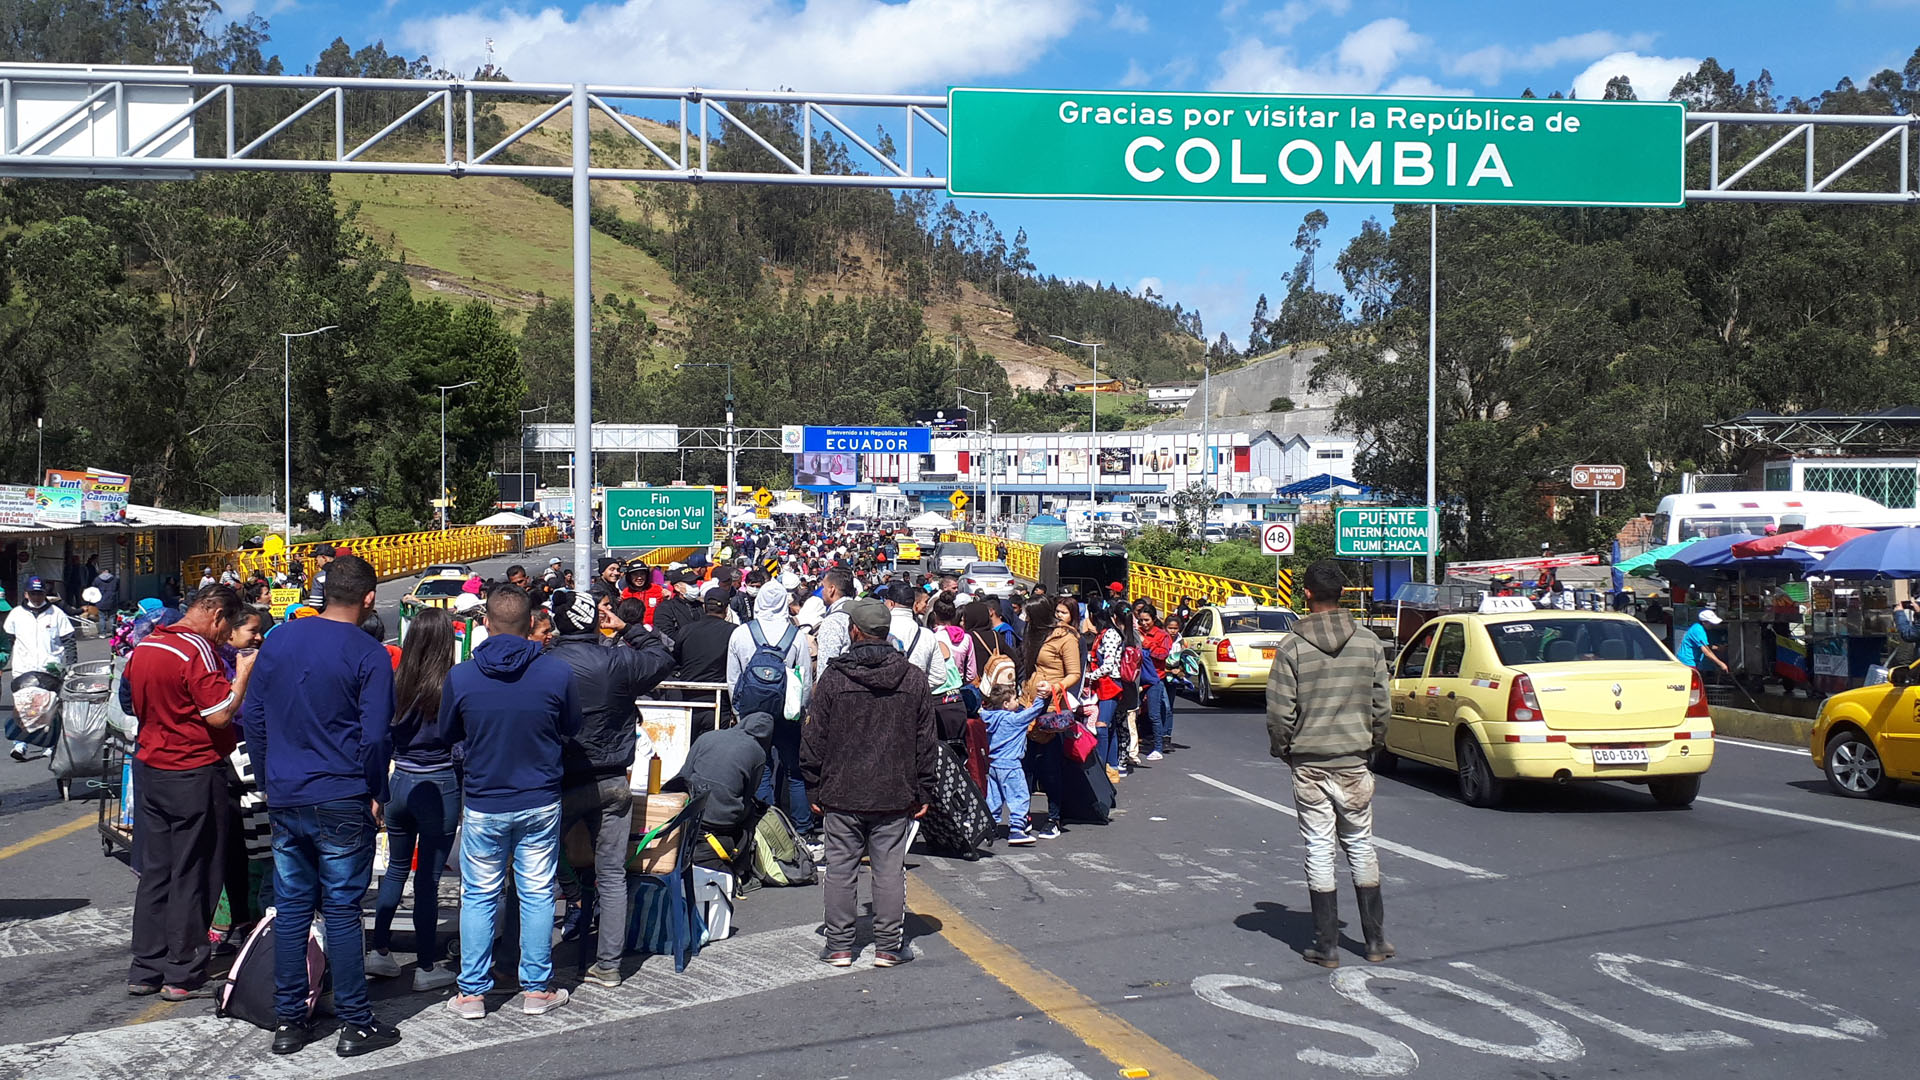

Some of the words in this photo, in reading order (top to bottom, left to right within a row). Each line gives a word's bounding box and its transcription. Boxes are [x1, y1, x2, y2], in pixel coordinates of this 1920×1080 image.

[1058, 101, 1174, 125] Gracias
[1184, 108, 1235, 131] por
[1244, 104, 1340, 129] visitar
[1350, 106, 1376, 129] la
[1386, 107, 1534, 137] República
[1545, 111, 1581, 132] de
[1124, 135, 1514, 188] COLOMBIA
[826, 438, 908, 451] ECUADOR
[87, 492, 123, 502] Cambio
[651, 493, 670, 504] Fin
[618, 506, 680, 518] Concesion
[684, 506, 705, 516] Vial
[621, 520, 656, 530] Unión
[659, 520, 678, 530] Del
[681, 518, 702, 530] Sur
[1358, 512, 1416, 525] PUENTE
[1268, 532, 1284, 544] 48
[1353, 540, 1422, 551] RUMICHACA
[1190, 951, 1881, 1078] SOLO
